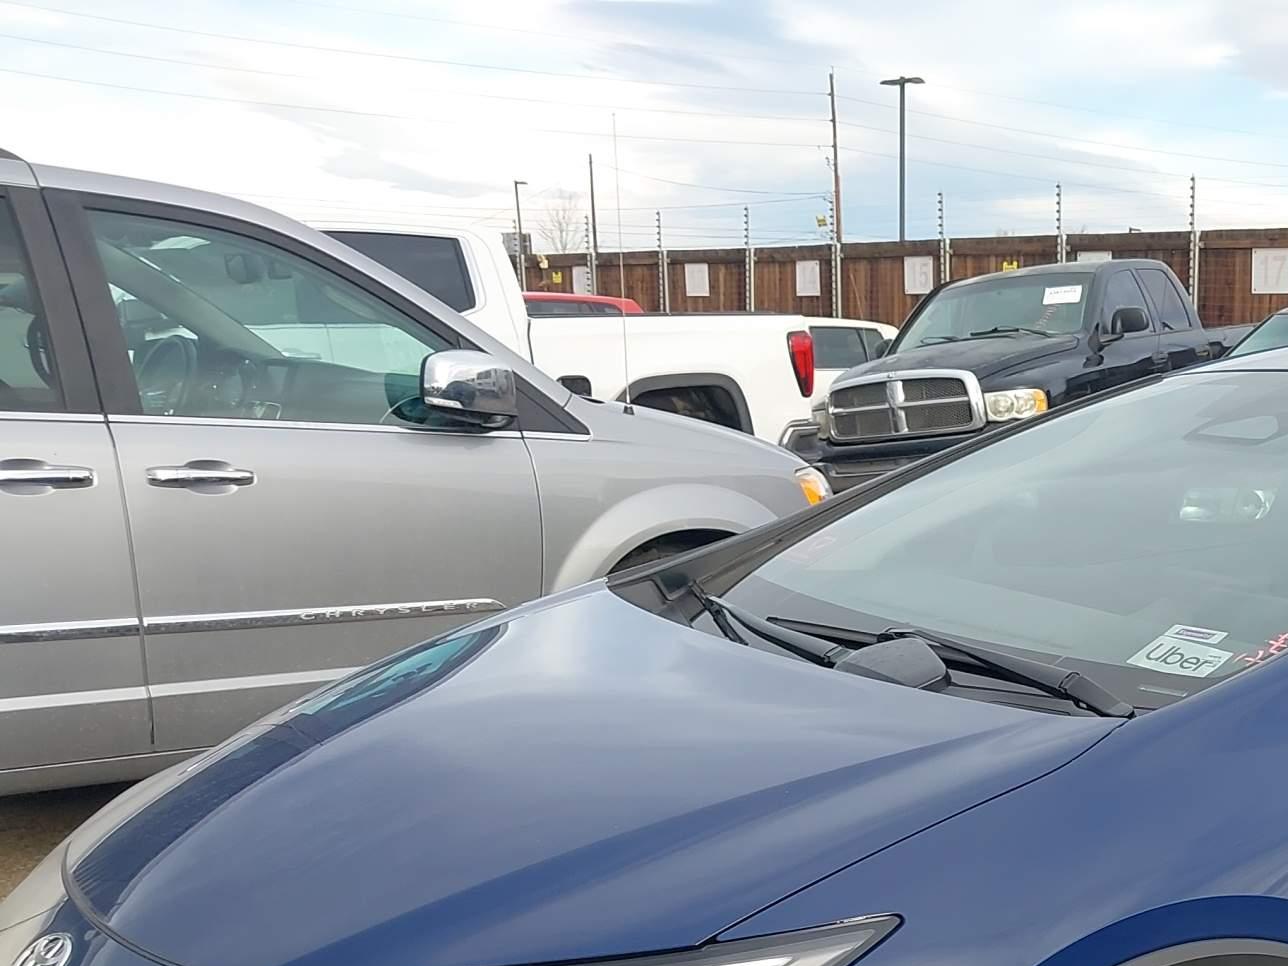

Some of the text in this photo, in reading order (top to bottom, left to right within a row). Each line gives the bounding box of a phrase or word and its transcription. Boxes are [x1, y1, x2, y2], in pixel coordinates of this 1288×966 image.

[1260, 256, 1287, 287] 17
[299, 602, 478, 620] CHRYSLER
[1145, 643, 1214, 672] Uber
